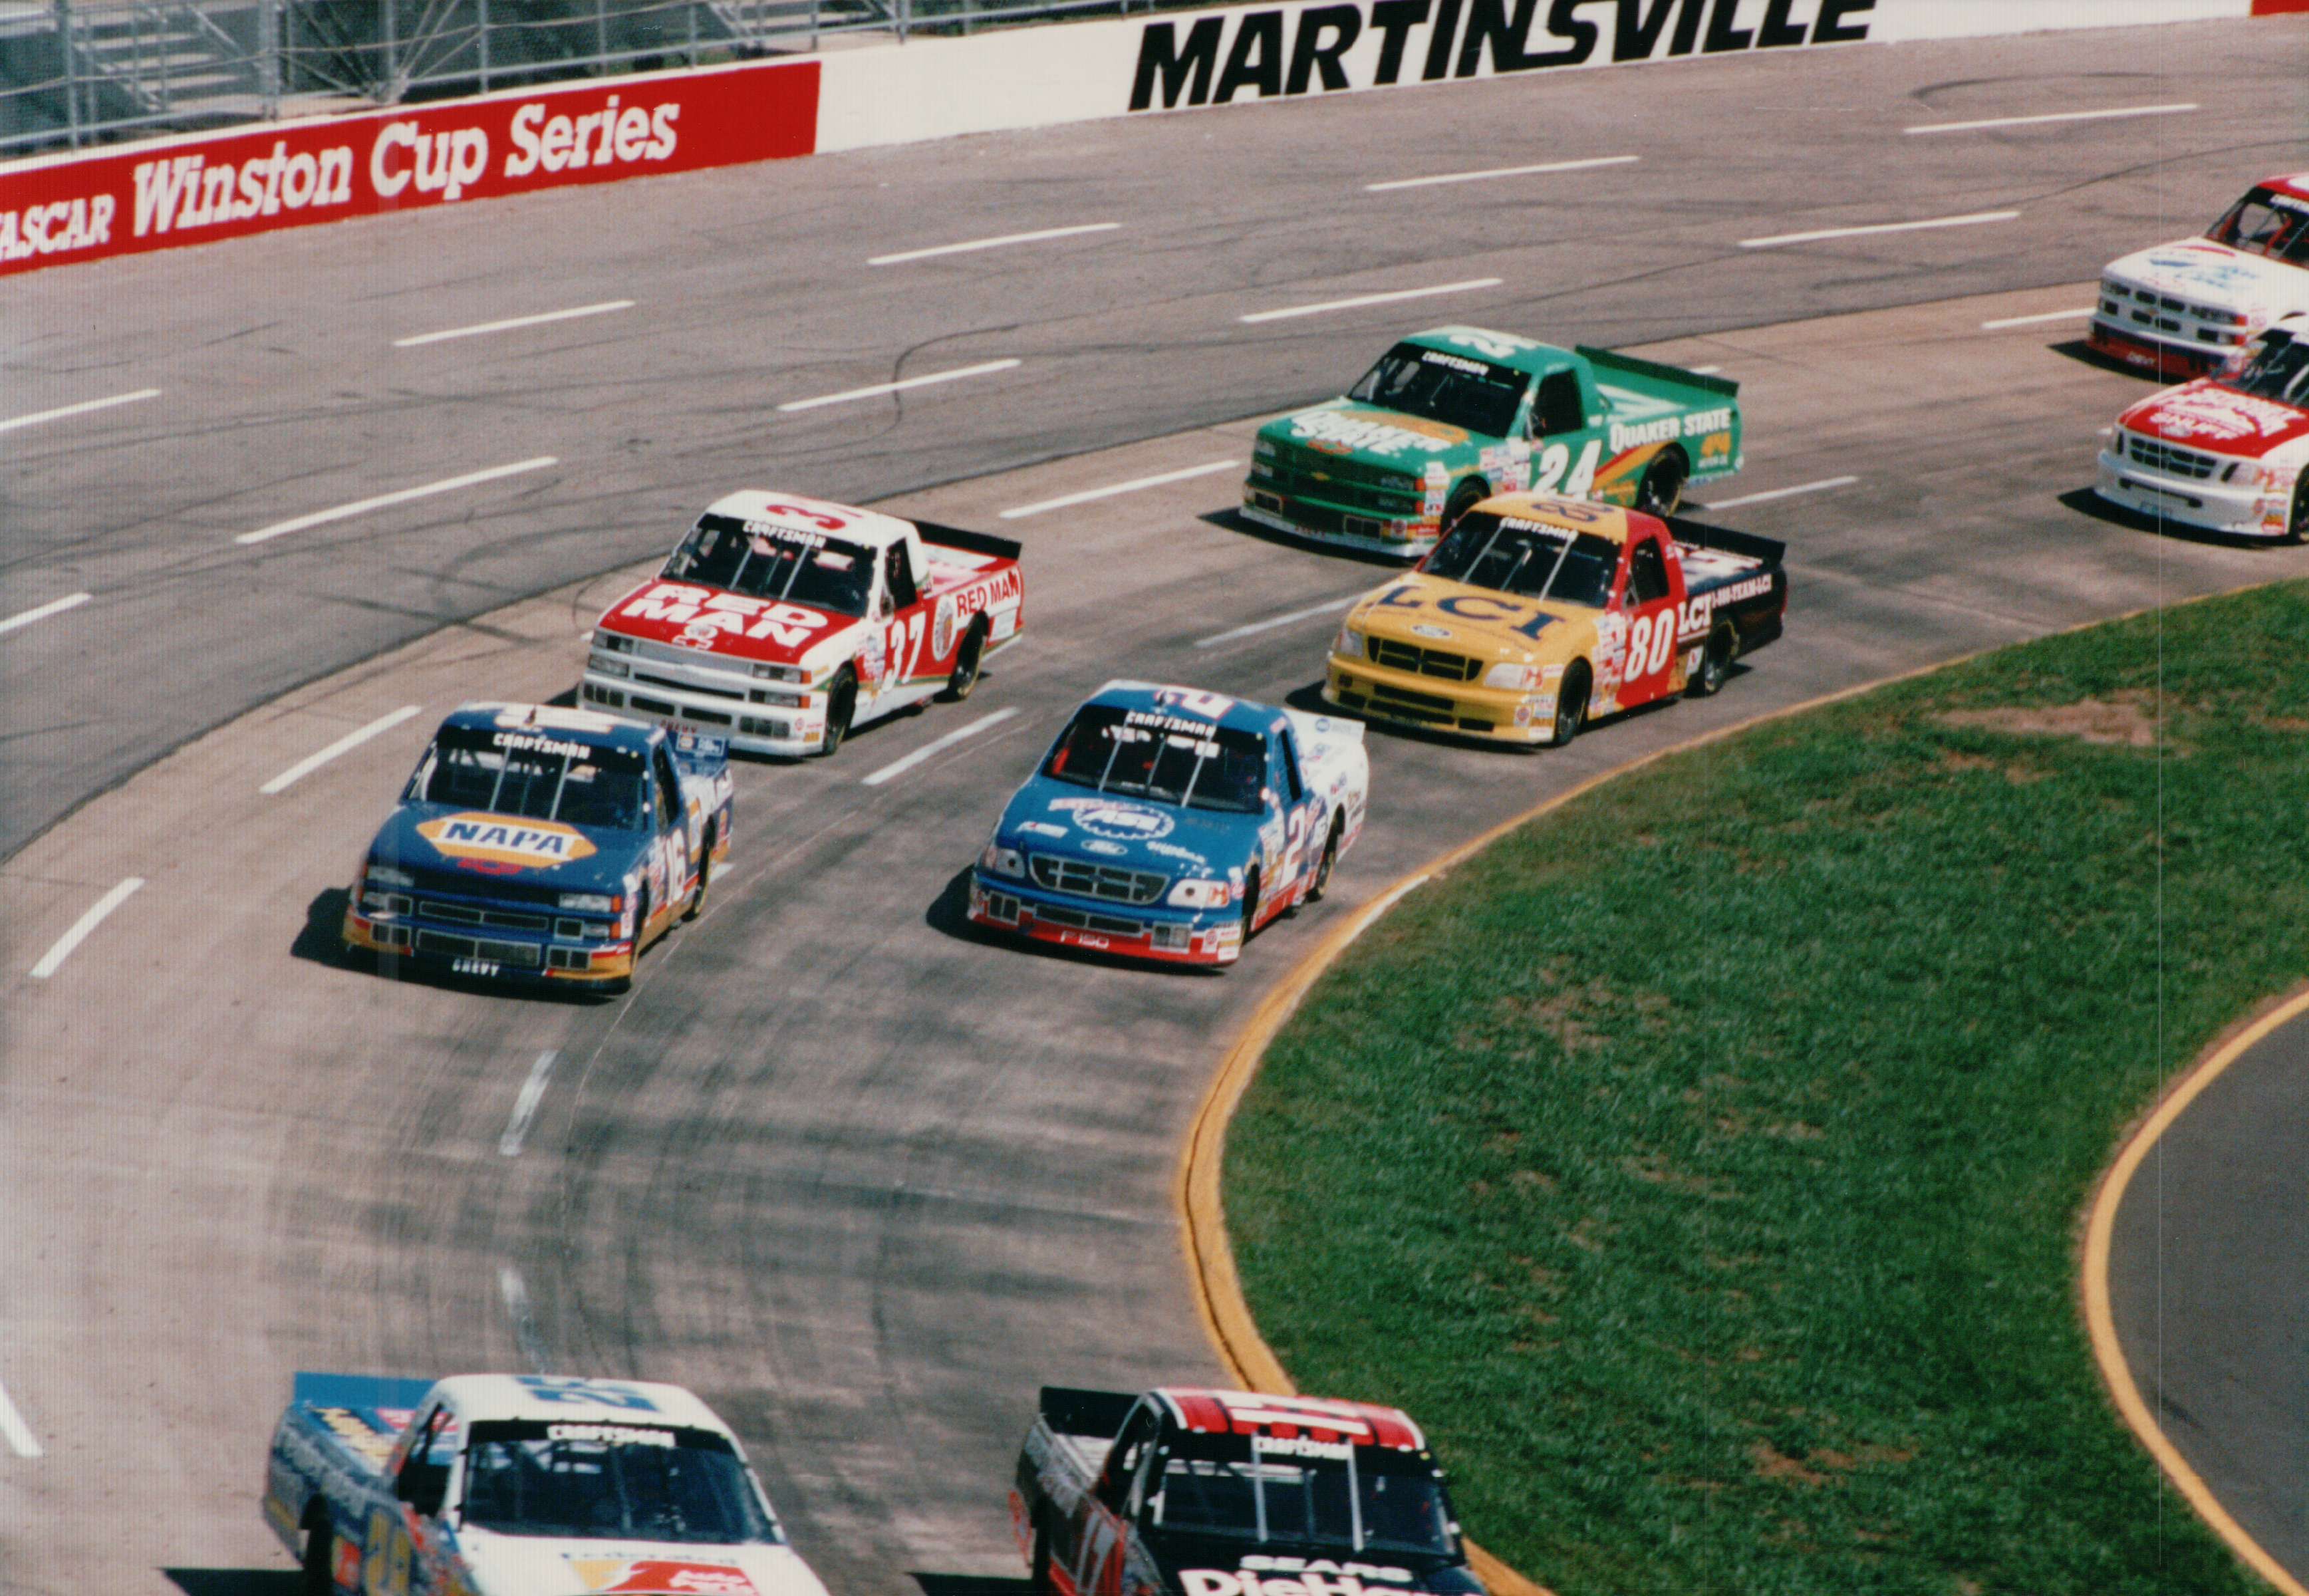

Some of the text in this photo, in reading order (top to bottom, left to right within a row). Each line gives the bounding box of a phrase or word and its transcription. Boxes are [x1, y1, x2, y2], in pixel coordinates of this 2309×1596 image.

[1129, 0, 1876, 112] MARTINSVILLE
[0, 94, 680, 261] ASCAR Winston Cup Series
[1610, 407, 1731, 454] QUAKER STATE
[1532, 440, 1602, 500] 24
[742, 520, 827, 548] CRAFTSMAN
[643, 583, 829, 628] RED
[956, 569, 1020, 618] RED MAN
[1365, 585, 1566, 640] LCI
[1677, 592, 1712, 635] LCI
[620, 598, 813, 648] MAN
[1623, 607, 1675, 683] 80
[881, 610, 927, 693] 37
[493, 732, 591, 759] CRAFTSMAN
[444, 822, 565, 854] NAPA
[1279, 803, 1306, 891] 2
[666, 828, 686, 906] 16
[452, 958, 499, 977] CHEVY
[1240, 1554, 1413, 1583] SEARS
